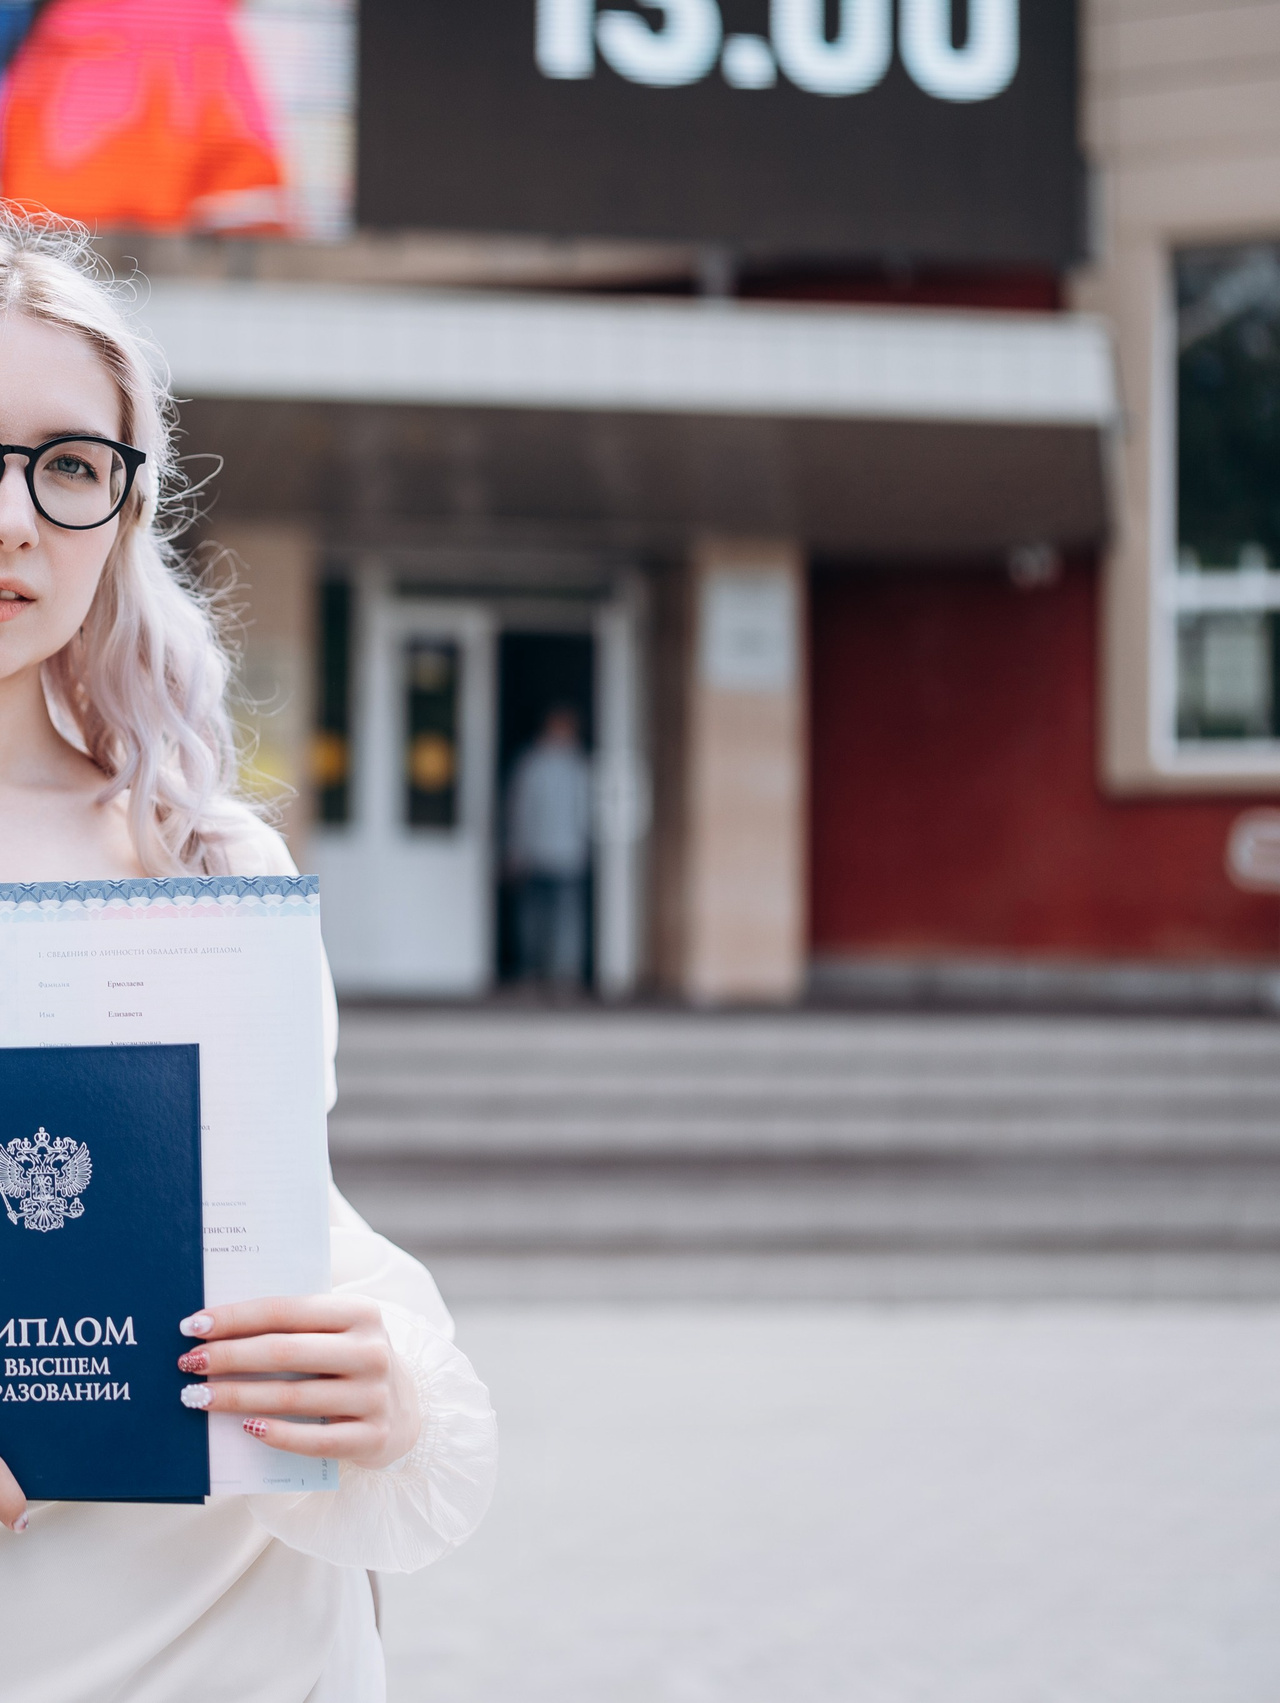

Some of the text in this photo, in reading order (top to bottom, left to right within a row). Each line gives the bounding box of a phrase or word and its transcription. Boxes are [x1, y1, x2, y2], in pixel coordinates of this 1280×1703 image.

[46, 950, 89, 958] СВЕДЕНИЯ
[90, 949, 97, 957] О
[99, 948, 145, 957] ЛИЧНОСТИ
[146, 947, 198, 955] ОБЛАДАТЕЛЯ
[200, 946, 242, 954] ДИПЛОМА
[107, 980, 144, 989] Ермолаева
[108, 1010, 143, 1018] Елизавета
[203, 1226, 247, 1234] ГВИСТИКА
[230, 1244, 247, 1252] 2023
[5, 1356, 111, 1376] ВЫСШЕМ
